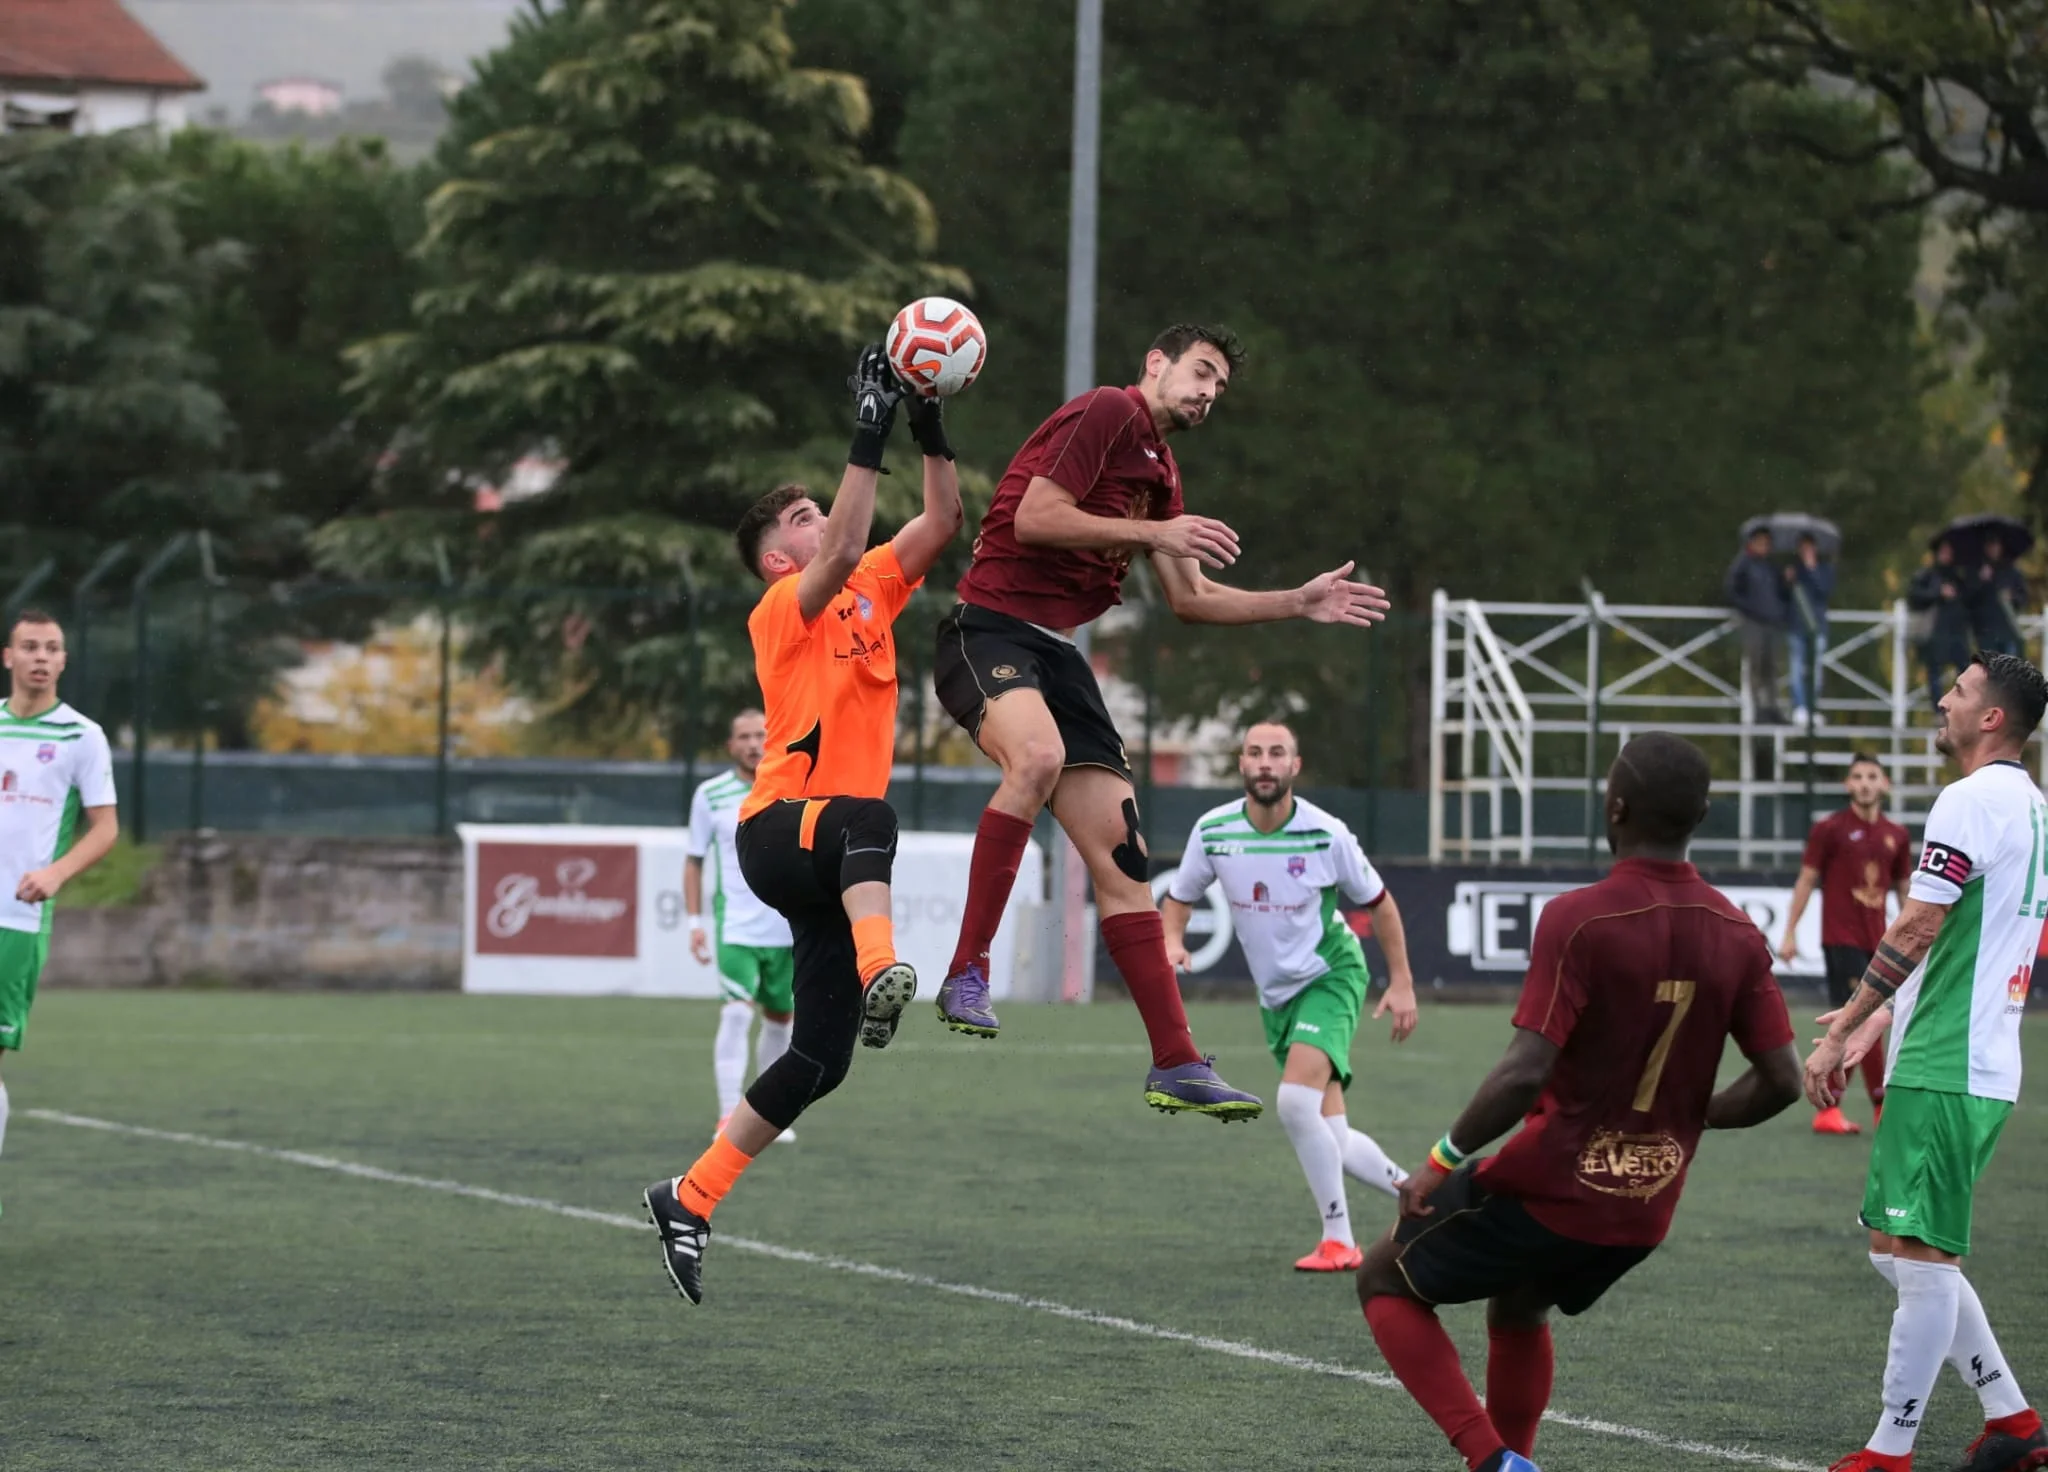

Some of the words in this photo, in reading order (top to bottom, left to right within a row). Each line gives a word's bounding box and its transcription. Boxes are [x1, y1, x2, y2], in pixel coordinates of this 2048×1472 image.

[1927, 848, 1948, 872] C
[1631, 981, 1697, 1113] 7
[1893, 1416, 1918, 1428] ZEUS
